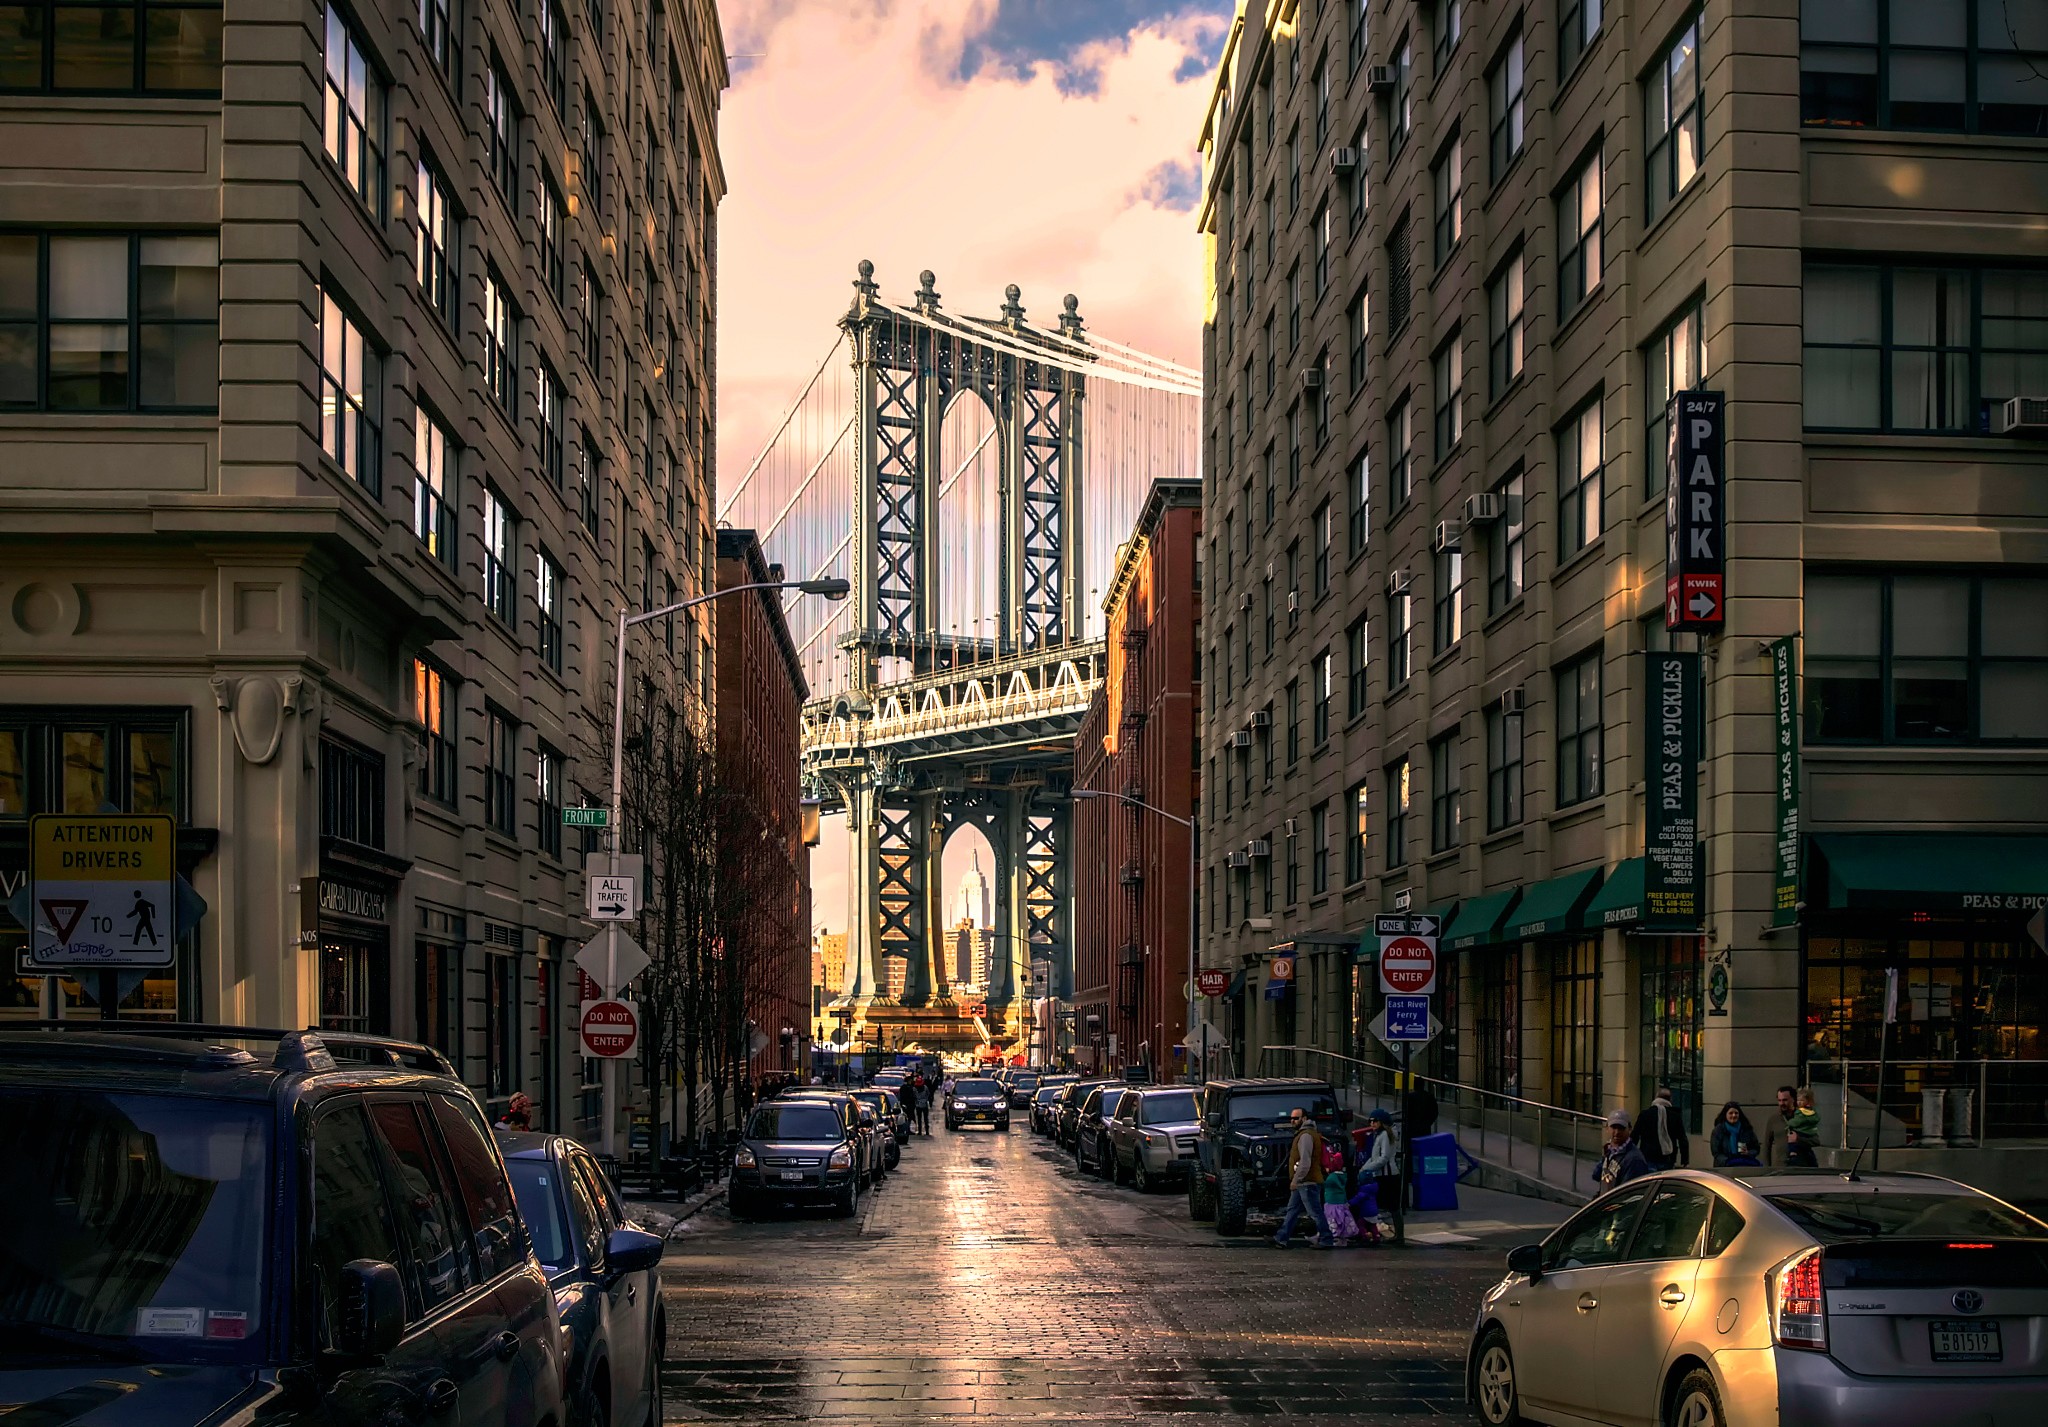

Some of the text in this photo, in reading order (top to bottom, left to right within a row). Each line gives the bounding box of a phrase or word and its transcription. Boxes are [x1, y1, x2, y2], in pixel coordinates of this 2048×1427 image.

[1686, 401, 1716, 414] 24/7
[1667, 423, 1678, 564] PARK
[1689, 419, 1716, 558] PARK
[1687, 580, 1717, 588] KWIK
[1778, 645, 1790, 725] PICKLES
[1662, 660, 1682, 810] PEAS & PICKLES
[1781, 729, 1791, 746] &
[1782, 751, 1792, 801] PEAS
[565, 810, 595, 823] FRONT
[52, 826, 153, 842] ATTENTION
[62, 852, 142, 868] DRIVERS
[602, 880, 623, 890] ALL
[598, 893, 628, 901] TRAFFIC
[1963, 895, 2048, 909] PEAS & PIC
[91, 917, 112, 933] TO
[1382, 921, 1399, 930] ONE
[302, 930, 316, 942] NOS
[1389, 948, 1427, 957] DO NOT
[1202, 974, 1223, 985] HAIR
[1392, 972, 1423, 981] ENTER
[590, 1012, 628, 1022] DO NOT
[1397, 1012, 1417, 1020] Ferry
[593, 1037, 624, 1046] ENTER
[149, 1320, 155, 1328] 2
[1953, 1333, 1988, 1351] 81519
